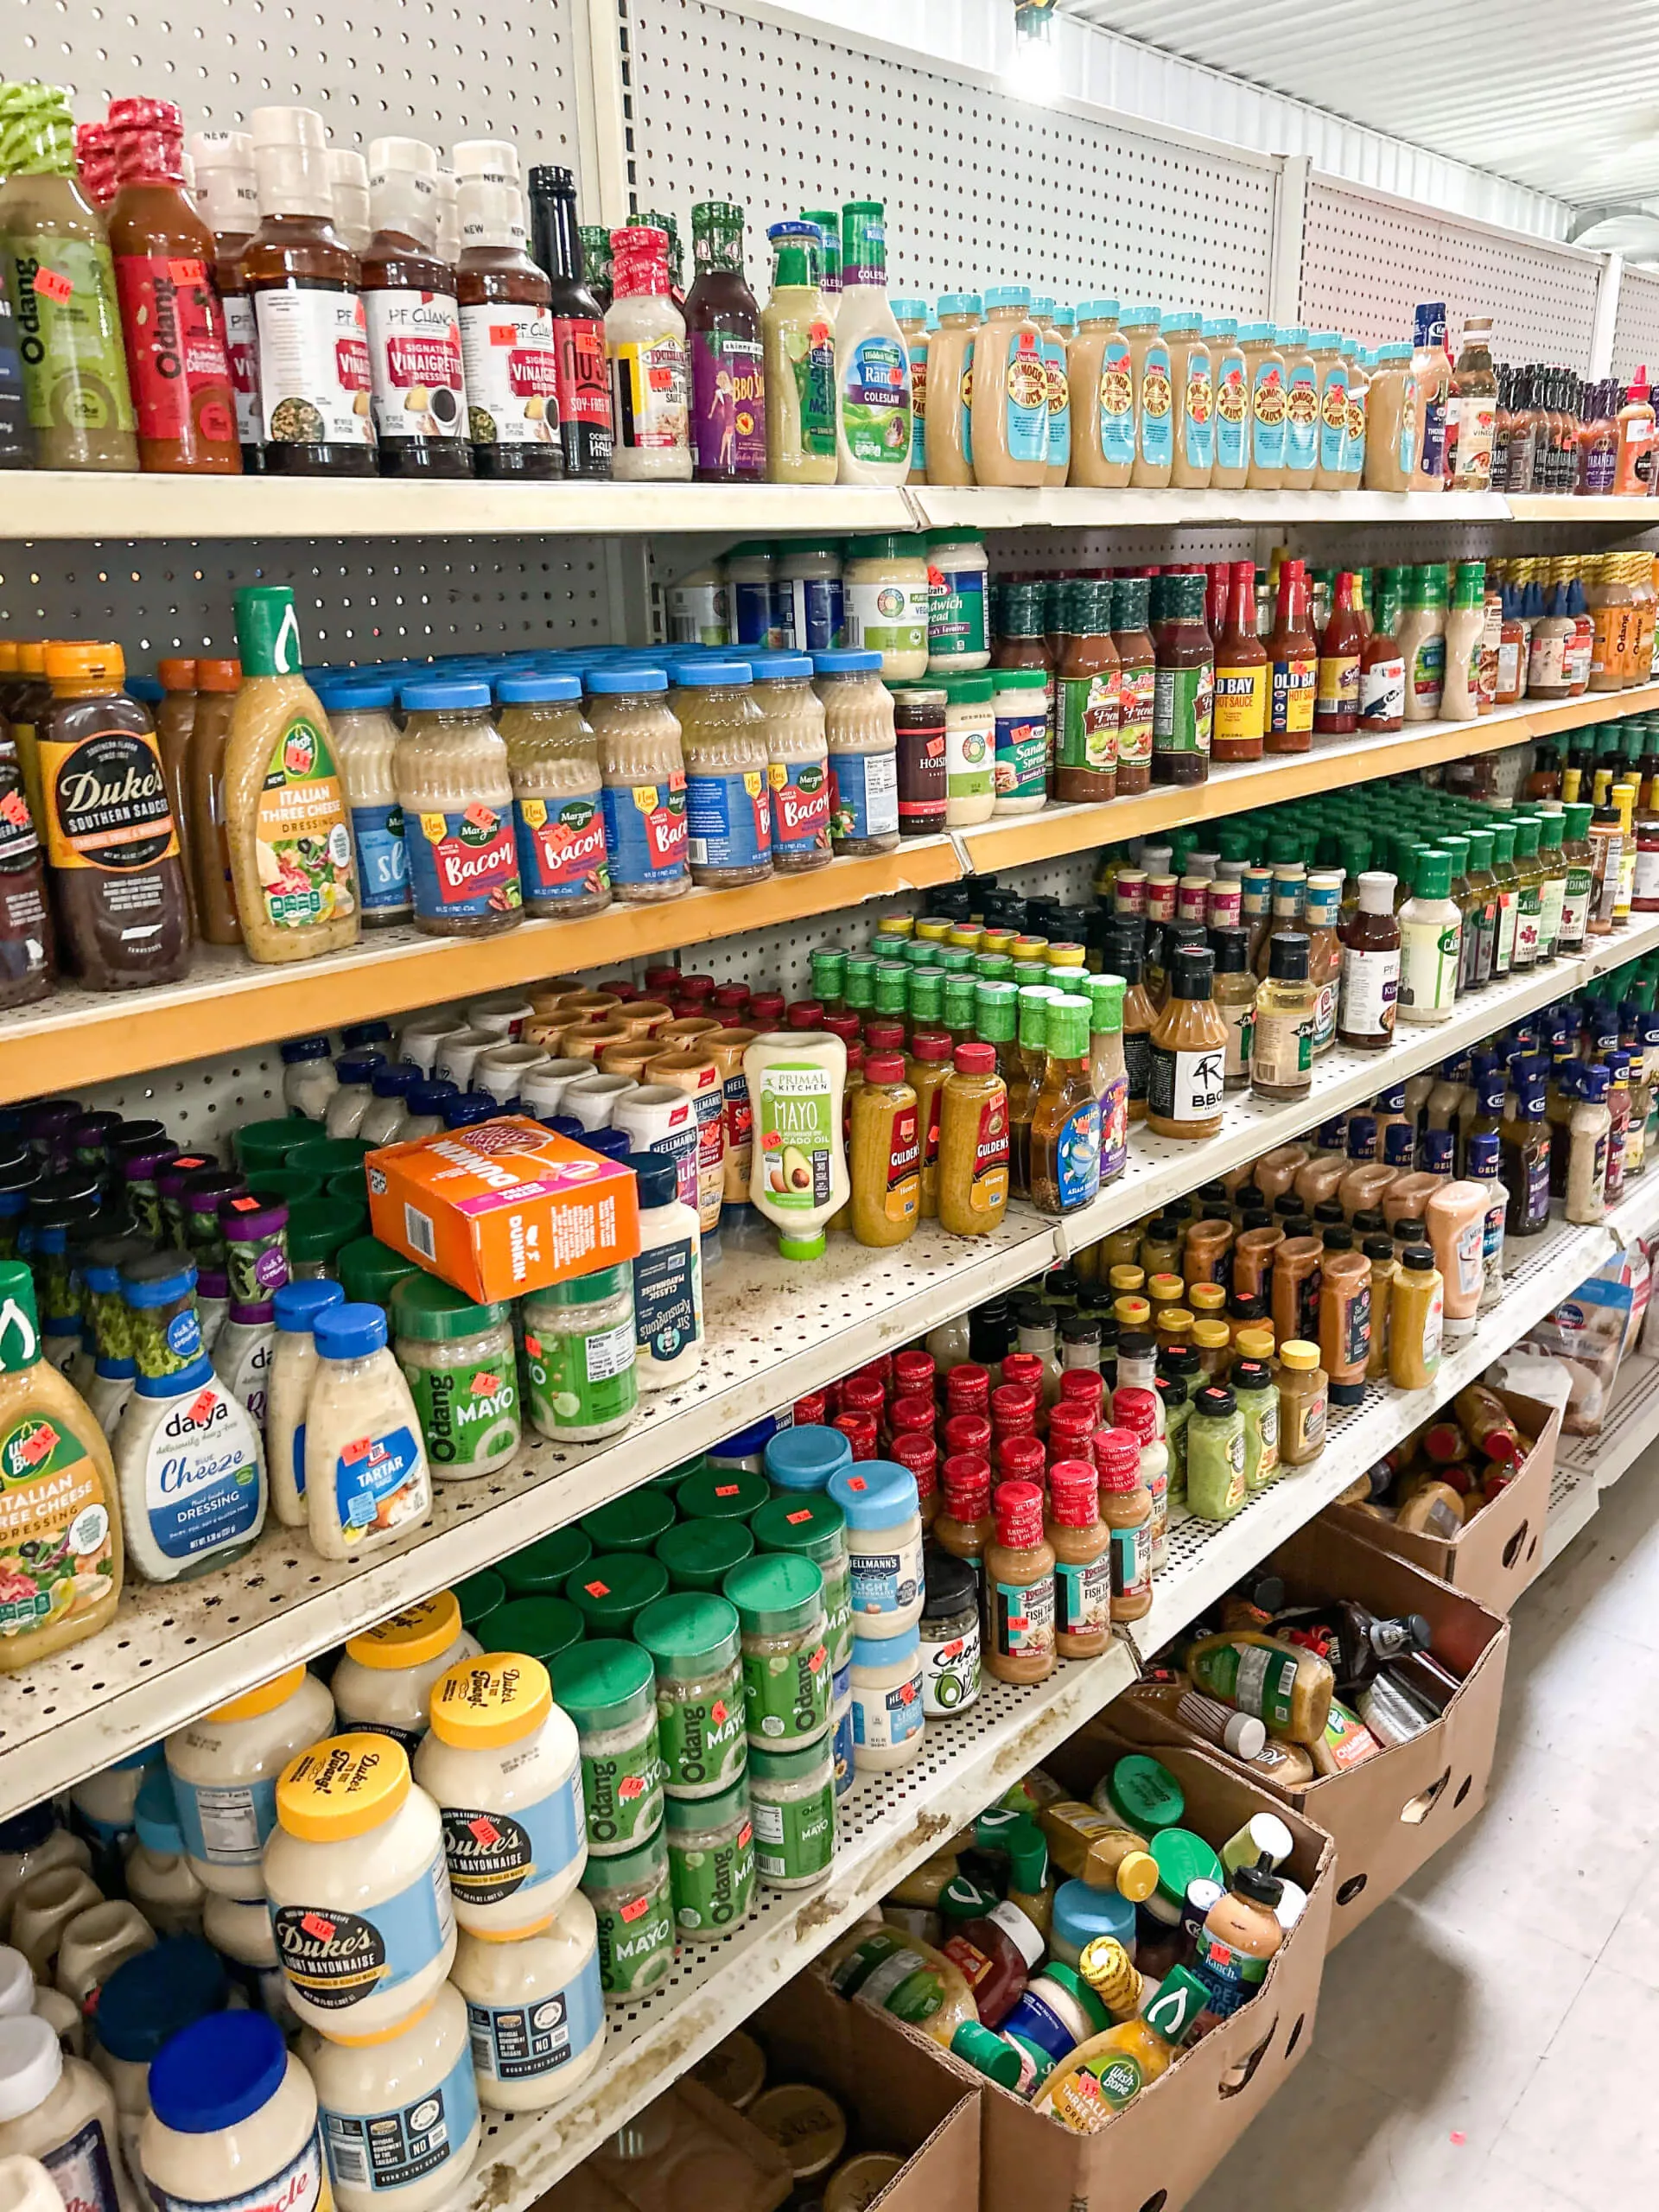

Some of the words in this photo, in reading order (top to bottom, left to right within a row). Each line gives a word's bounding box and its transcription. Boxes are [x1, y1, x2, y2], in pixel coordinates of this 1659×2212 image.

[464, 225, 484, 235] NEW
[405, 344, 454, 357] SIGNATURE
[866, 366, 892, 384] Ranc
[733, 375, 754, 403] BBQ
[865, 391, 899, 404] COLESLAW
[929, 596, 963, 613] dwich
[929, 610, 949, 622] read
[1227, 677, 1254, 695] BAY
[1274, 673, 1300, 690] OLD
[1230, 694, 1254, 708] SAUCE
[1288, 690, 1301, 702] HOT
[1302, 689, 1314, 702] SAU
[60, 763, 164, 813] Duke's
[279, 785, 330, 806] ITALIAN
[260, 805, 305, 823] THREE
[785, 787, 833, 828] Bacon
[68, 806, 131, 833] SOUTHERN
[544, 827, 605, 870] Bacon
[378, 842, 404, 883] sl
[444, 842, 514, 887] Bacon
[779, 1072, 827, 1085] PRIMAL
[779, 1084, 828, 1092] KITCHEN
[774, 1100, 819, 1132] MAYO
[814, 1135, 830, 1144] OIL
[977, 1134, 1009, 1159] GULDEN'S
[891, 1141, 920, 1166] GULDEN'S
[984, 1173, 1004, 1187] Honey
[649, 1284, 677, 1301] CLASSIC
[677, 1315, 690, 1331] Sir
[456, 1386, 514, 1426] MAYO
[165, 1402, 229, 1438] daya
[428, 1374, 455, 1462] O'dang
[194, 1452, 214, 1466] BLUE
[160, 1449, 245, 1493] Cheeze
[356, 1455, 404, 1488] TARTAR
[0, 1473, 73, 1514] TALIAN
[0, 1509, 31, 1529] REE
[35, 1479, 93, 1517] CHEESE
[177, 1491, 239, 1523] DRESSING
[855, 1581, 891, 1592] LIGHT
[1084, 1586, 1102, 1599] FISH
[1026, 1607, 1043, 1621] FISH
[500, 1668, 521, 1705] Duke's
[678, 1705, 707, 1783] O'dang
[707, 1703, 747, 1750] MAYO
[345, 1751, 380, 1795] Duke's
[620, 1758, 662, 1807] AYO
[588, 1760, 617, 1841] O'dang
[801, 1819, 829, 1841] MAYO
[460, 1852, 523, 1871] MAYONNAISE
[709, 1847, 734, 1924] O'dang
[276, 1923, 375, 1959] Duke's
[615, 1918, 671, 1962] MAYO
[308, 1954, 376, 1974] MAYONNAISE
[536, 2037, 550, 2052] NO
[1103, 2075, 1130, 2095] Bone
[1109, 2065, 1135, 2087] Wish-
[1061, 2082, 1090, 2120] THREE
[1065, 2104, 1086, 2131] DRES
[412, 2139, 428, 2155] NO
[402, 2171, 410, 2180] IN
